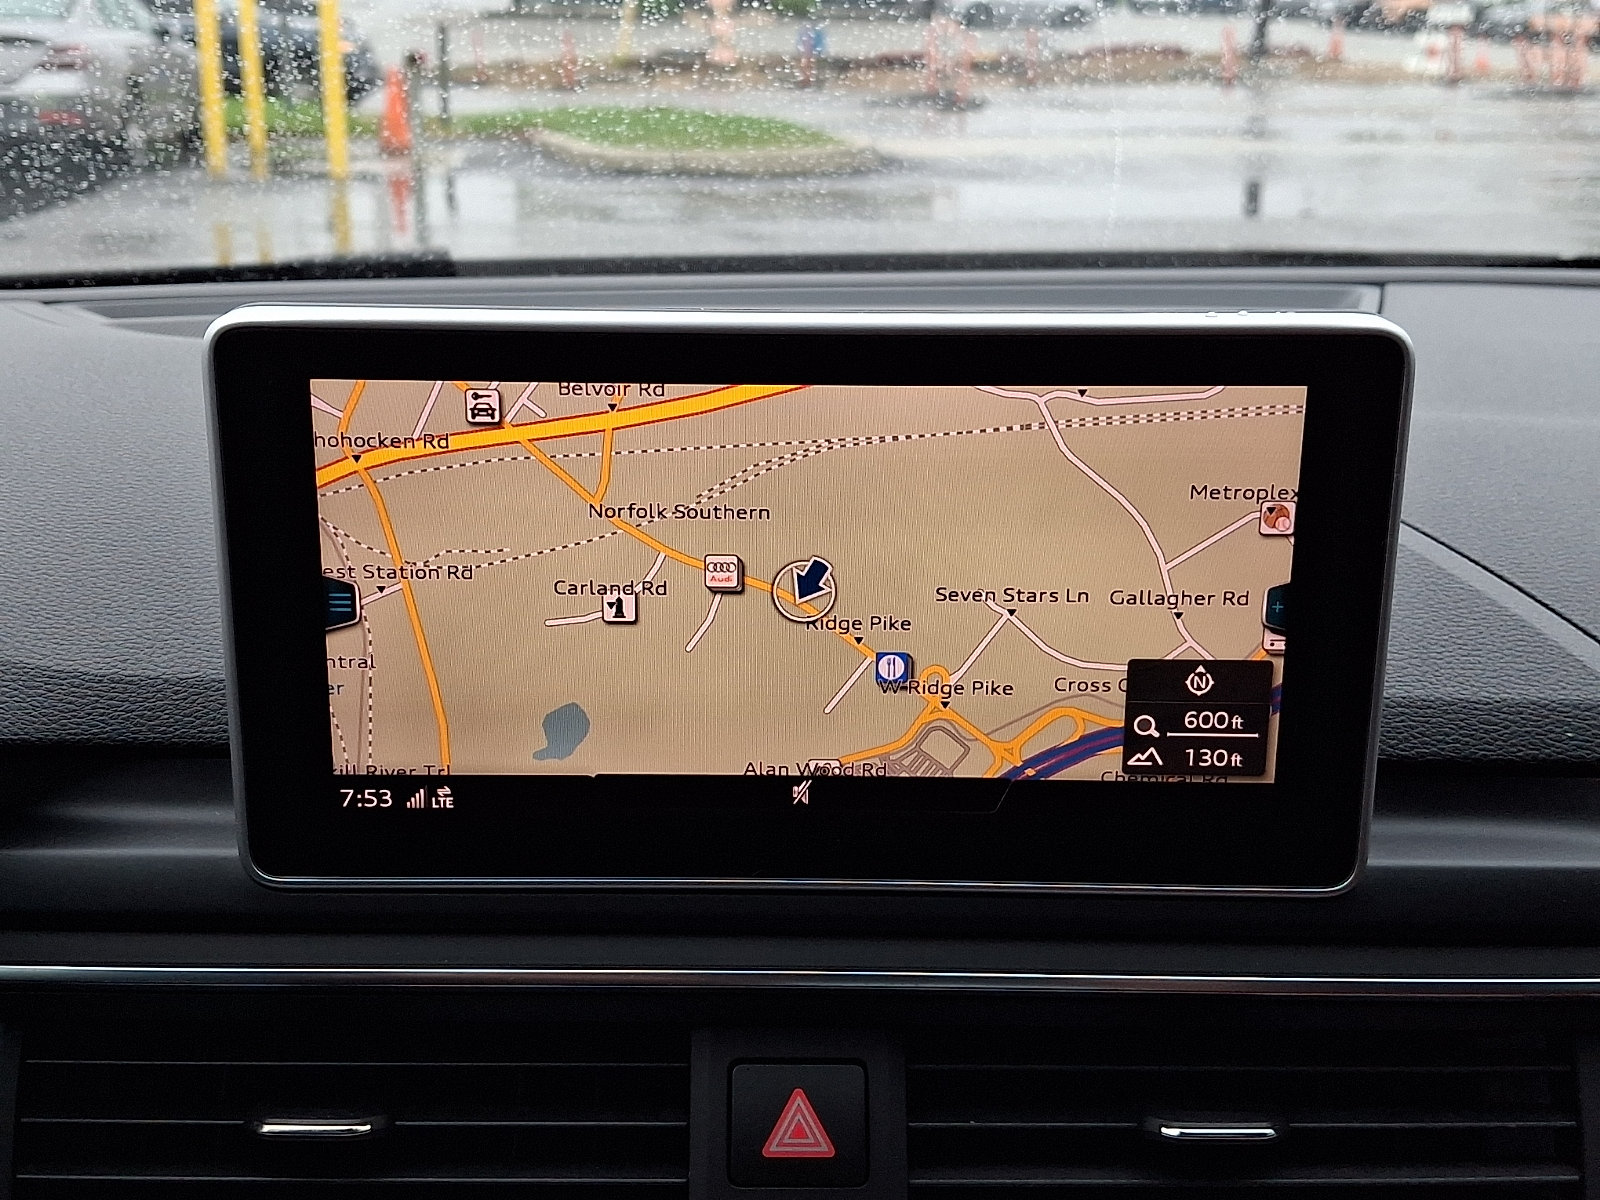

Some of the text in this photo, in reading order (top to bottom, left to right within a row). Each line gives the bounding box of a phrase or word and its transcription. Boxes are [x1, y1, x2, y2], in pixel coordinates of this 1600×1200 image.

[558, 383, 665, 397] Belvoir Rd
[423, 433, 449, 449] Rd
[1190, 484, 1299, 505] Metroplex
[589, 503, 771, 520] Norfolk Southern
[363, 565, 440, 580] Station
[447, 565, 473, 580] Rd
[709, 575, 733, 583] Audi
[553, 579, 667, 596] Carland Rd
[935, 587, 1089, 603] Seven Stars Ln
[1109, 590, 1250, 610] Gallagher Rd
[806, 615, 912, 634] Ridge Pike
[878, 680, 1014, 699] W Ridge Pike
[1054, 677, 1111, 692] Cross
[743, 762, 887, 777] Alan Wood Rd
[339, 789, 393, 808] 7:53
[432, 797, 454, 808] LTE
